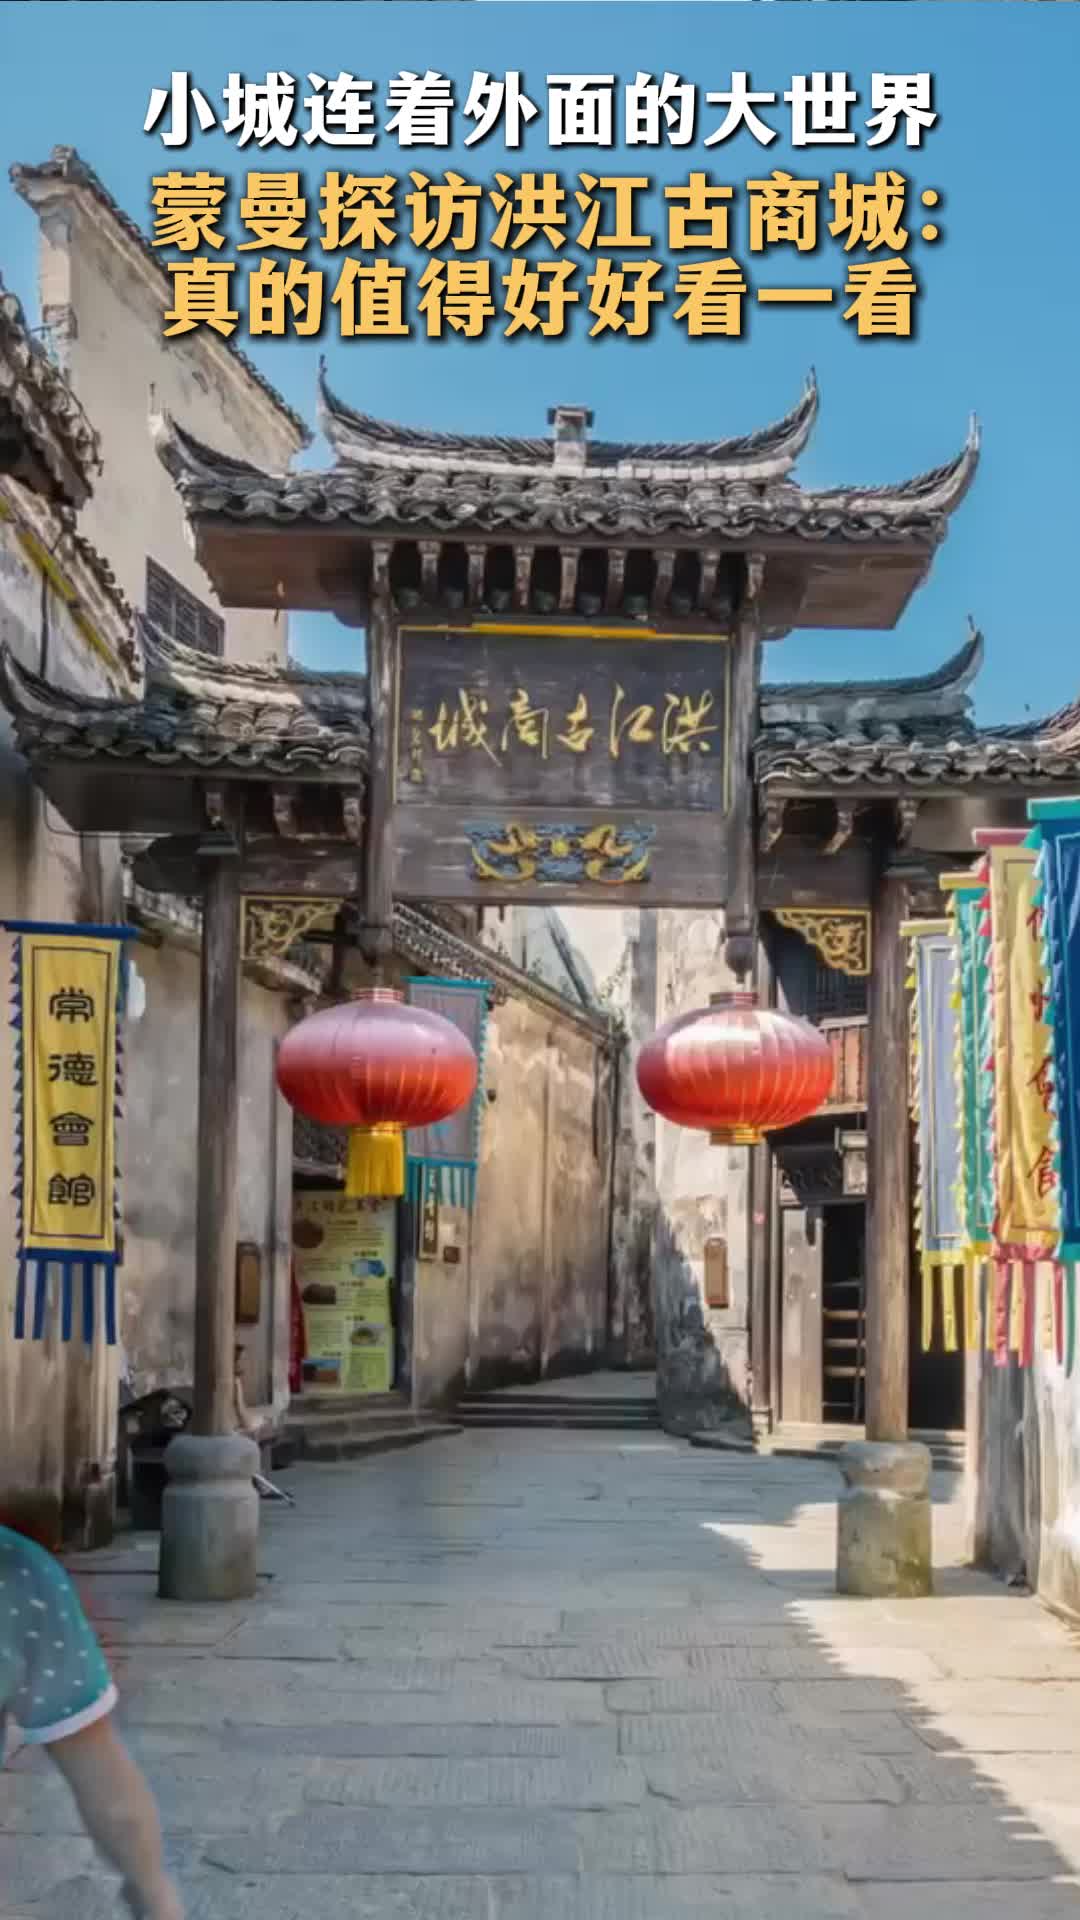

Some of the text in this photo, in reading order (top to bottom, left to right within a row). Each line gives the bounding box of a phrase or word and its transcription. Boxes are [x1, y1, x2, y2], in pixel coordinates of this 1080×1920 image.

[429, 683, 718, 767] 洪江古商城
